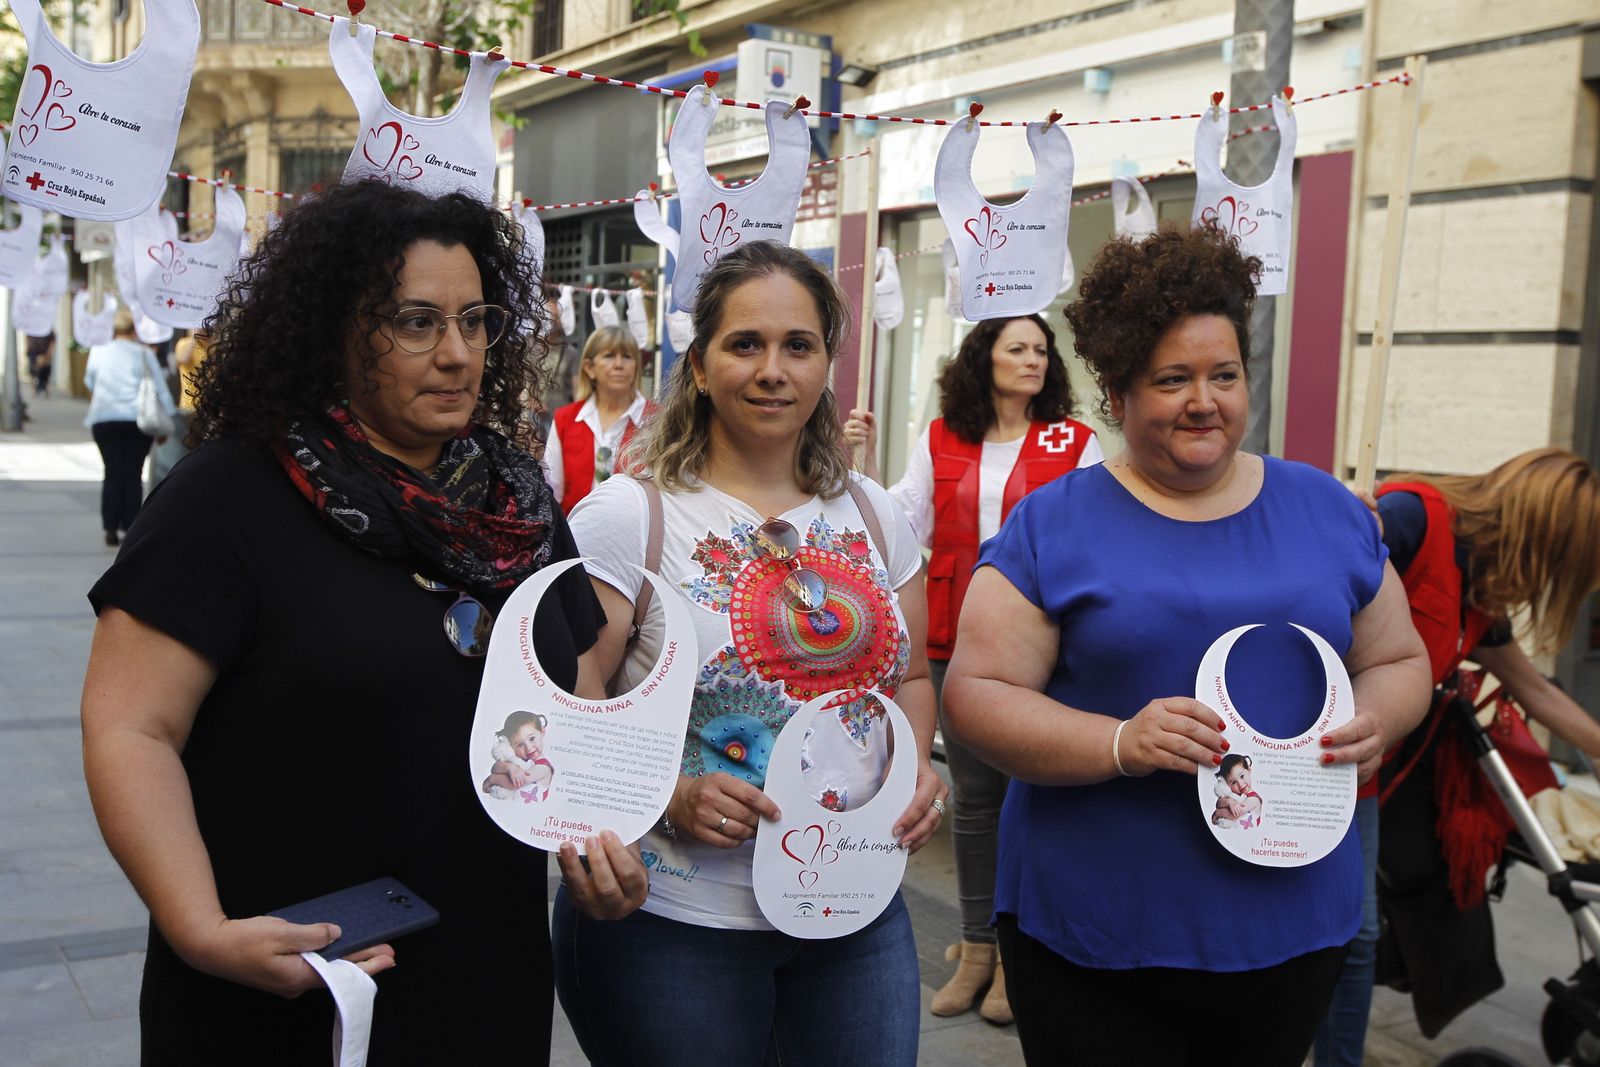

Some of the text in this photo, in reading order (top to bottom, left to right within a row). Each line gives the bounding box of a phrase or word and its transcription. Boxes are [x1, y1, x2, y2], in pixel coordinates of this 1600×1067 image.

[78, 102, 142, 132] Abre tu corazón
[38, 158, 66, 172] Familiar
[70, 168, 84, 178] 950
[85, 172, 94, 180] 25
[96, 176, 104, 184] 71
[105, 178, 114, 187] 66
[444, 161, 452, 170] tu
[48, 180, 106, 205] Cruz Roja Española
[552, 692, 603, 714] NINGUNA
[641, 681, 658, 698] SIN
[656, 641, 678, 681] HOGAR
[1252, 736, 1292, 750] NINGUNA
[1318, 718, 1329, 732] SIN
[1326, 685, 1336, 718] HOGAR
[530, 826, 566, 840] hacerles
[560, 820, 593, 832] puedes
[837, 836, 857, 851] Abre
[858, 838, 868, 852] tu
[1274, 840, 1298, 848] puedes
[1251, 848, 1280, 856] hacerles
[782, 892, 816, 900] Acogimiento
